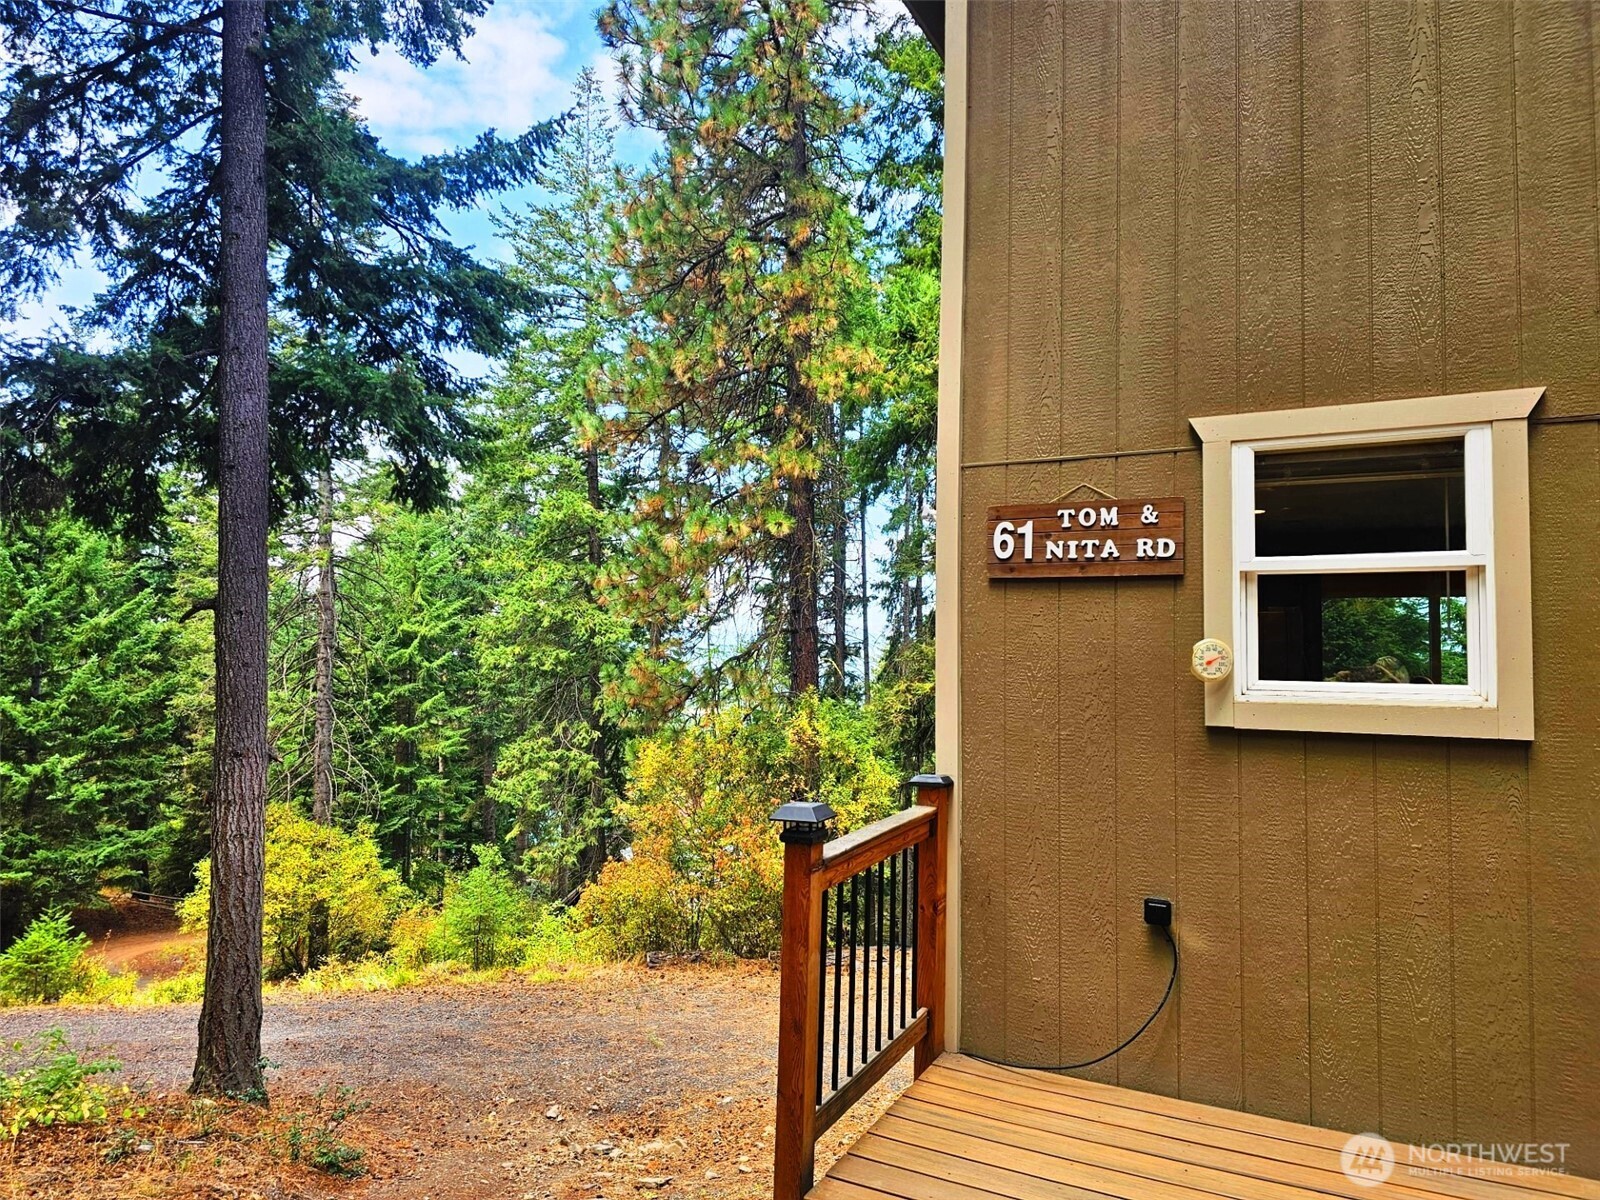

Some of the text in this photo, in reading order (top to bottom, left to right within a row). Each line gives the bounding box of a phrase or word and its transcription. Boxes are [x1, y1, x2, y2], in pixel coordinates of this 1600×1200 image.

[1057, 504, 1158, 528] TOM &
[993, 520, 1033, 559] 61
[1045, 538, 1176, 559] NITA RD
